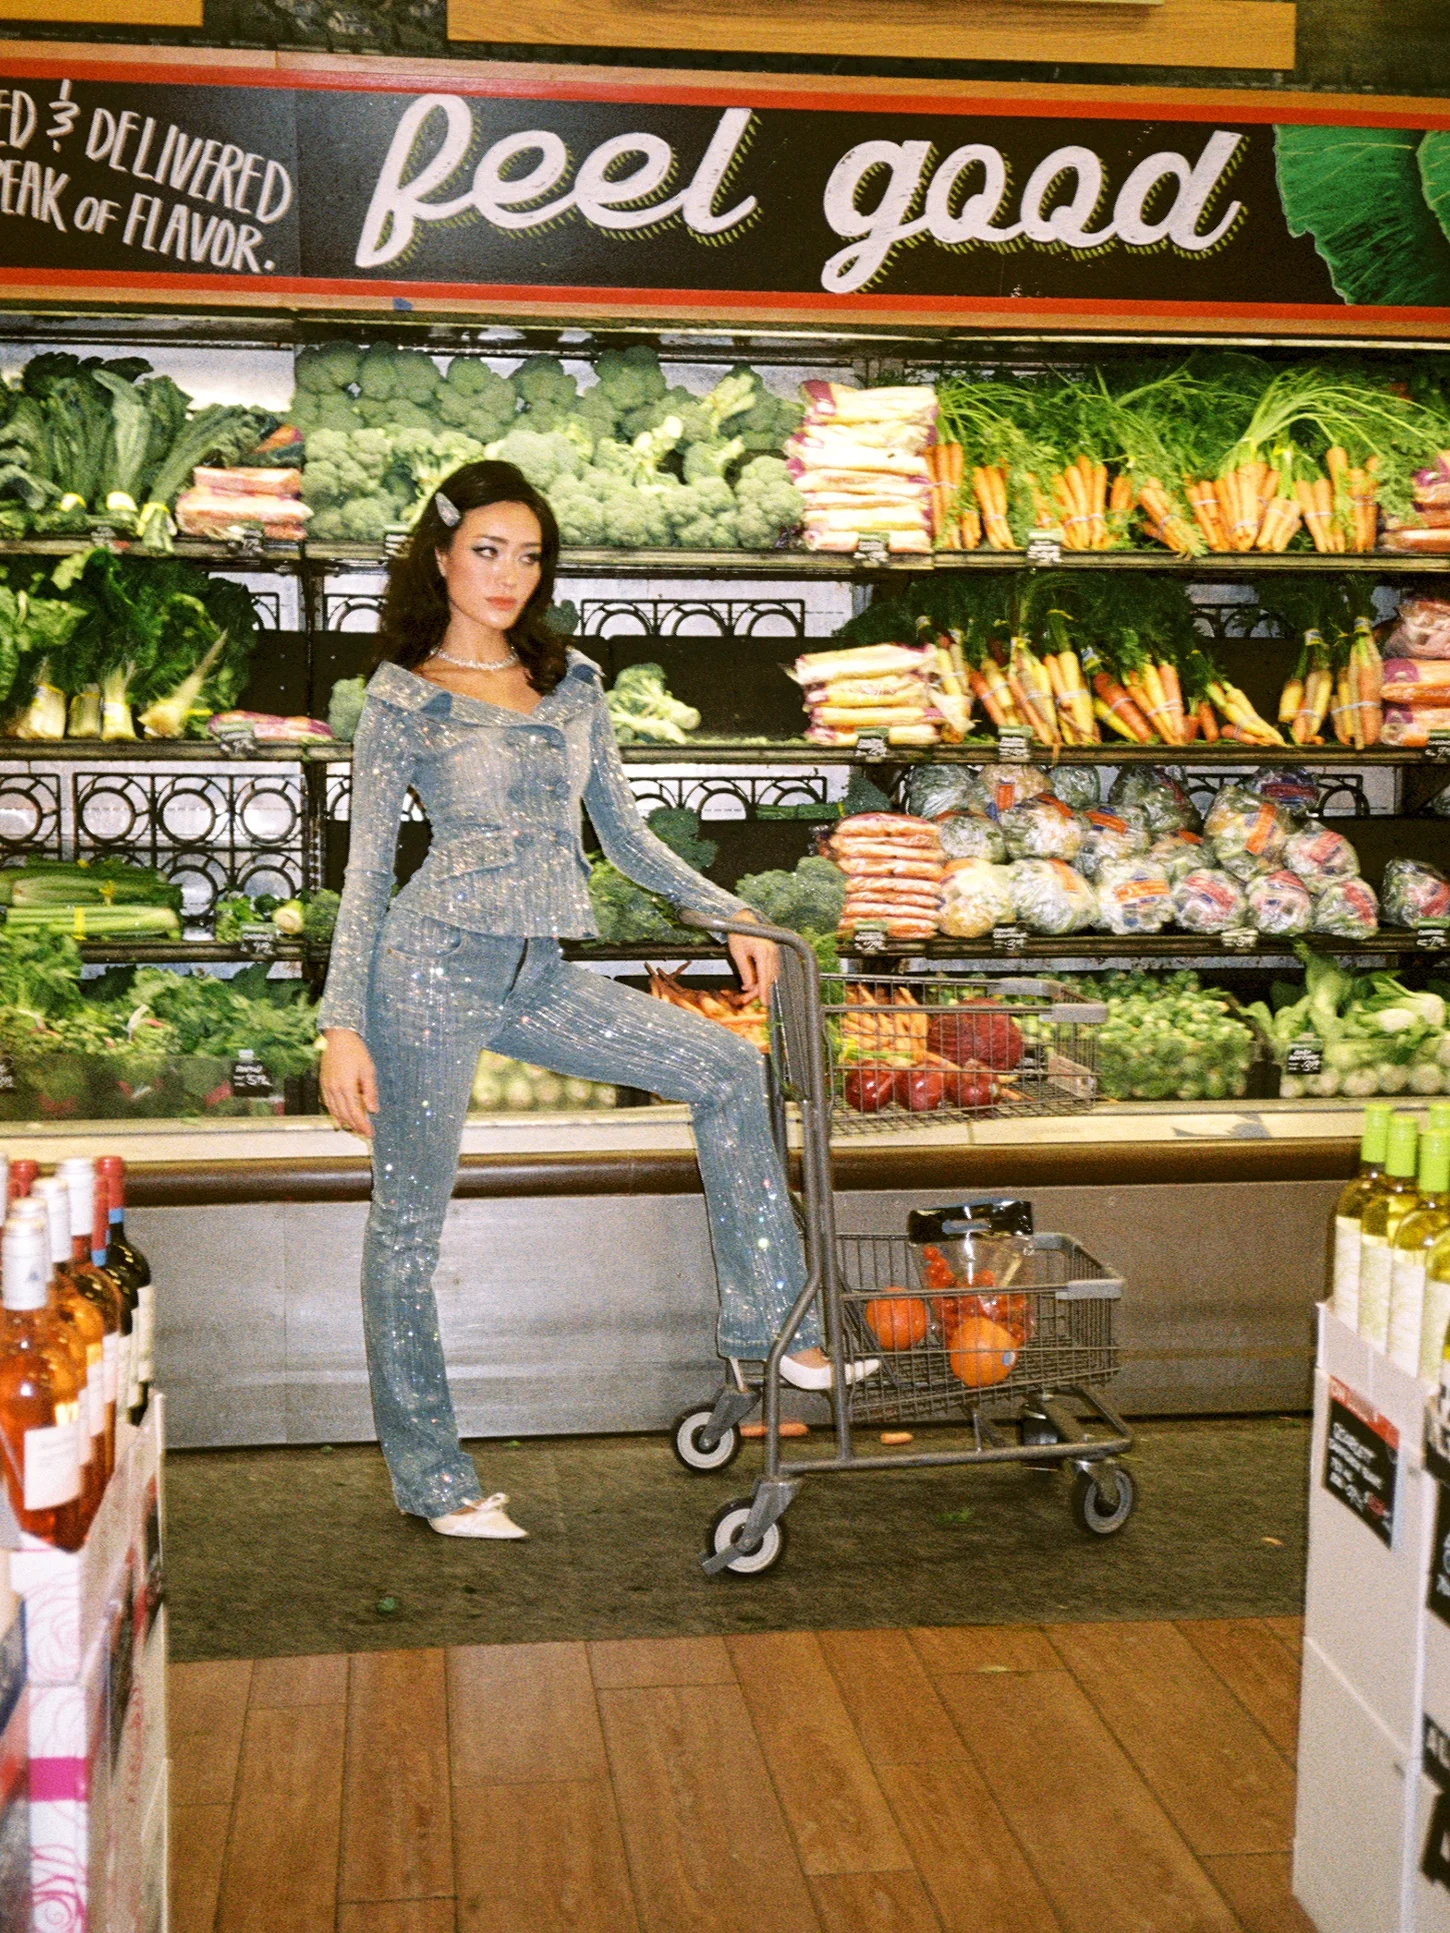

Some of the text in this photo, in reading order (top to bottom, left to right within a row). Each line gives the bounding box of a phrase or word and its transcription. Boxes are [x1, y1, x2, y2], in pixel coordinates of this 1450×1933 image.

[0, 159, 276, 273] EAK OF FLAVOR.
[46, 79, 80, 152] &
[86, 108, 293, 224] DELIVERED
[355, 93, 1247, 294] feel good
